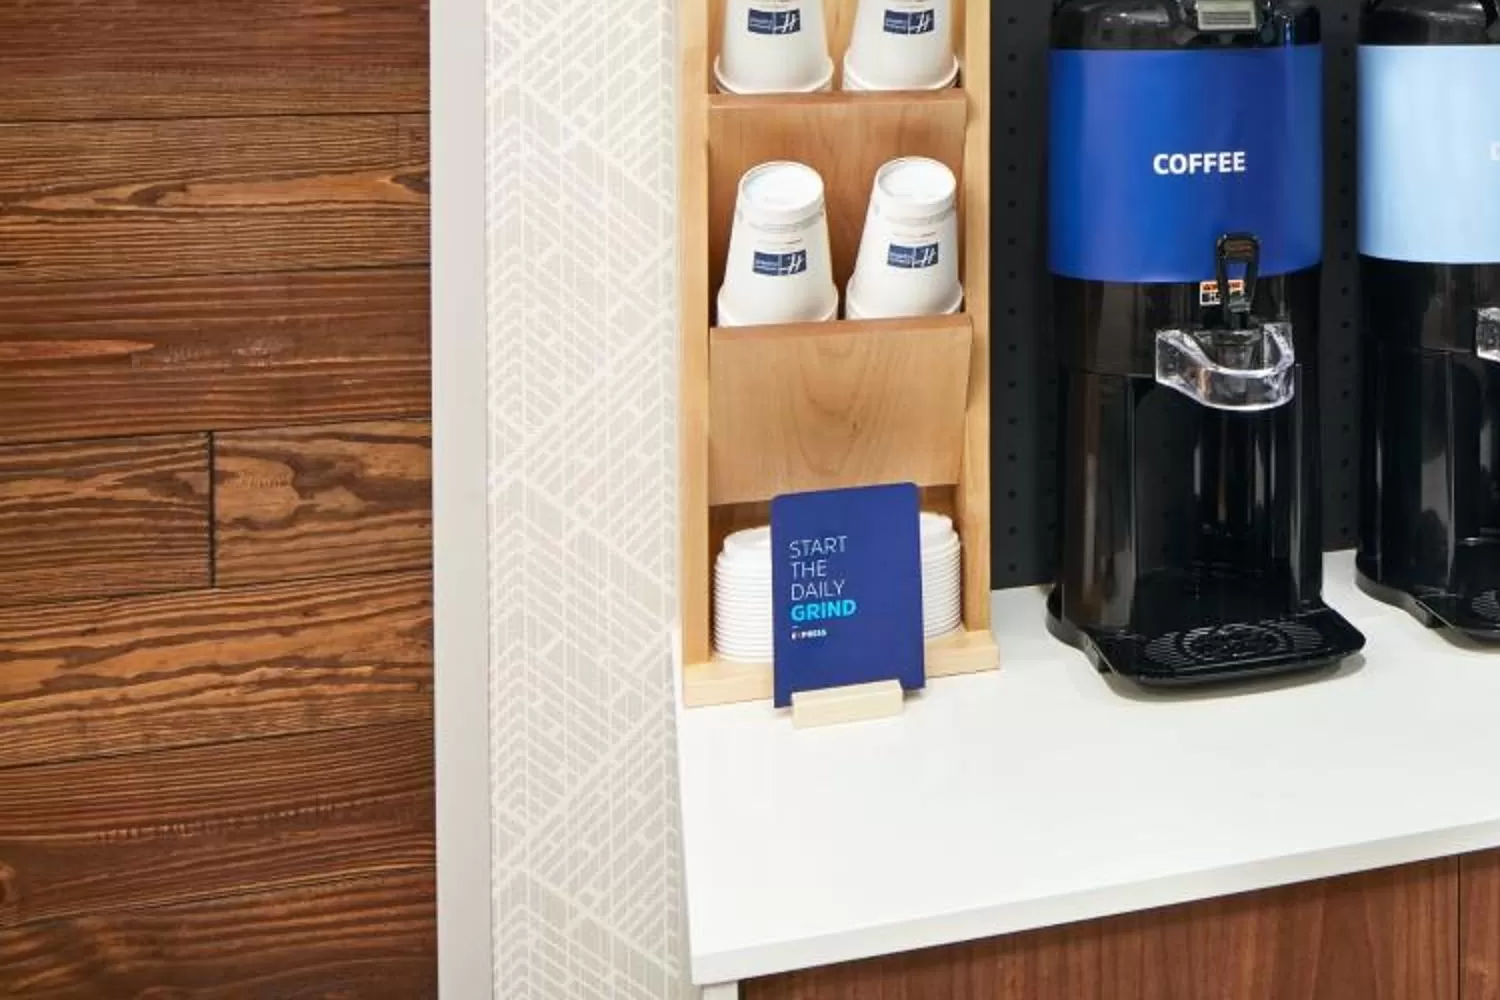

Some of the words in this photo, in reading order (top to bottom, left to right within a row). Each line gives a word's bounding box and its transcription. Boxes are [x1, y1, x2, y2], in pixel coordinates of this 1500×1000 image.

[1152, 151, 1246, 175] COFFEE
[789, 535, 848, 559] START
[790, 559, 828, 579] THE
[791, 579, 845, 601] DAILY
[791, 599, 857, 621] GRIND
